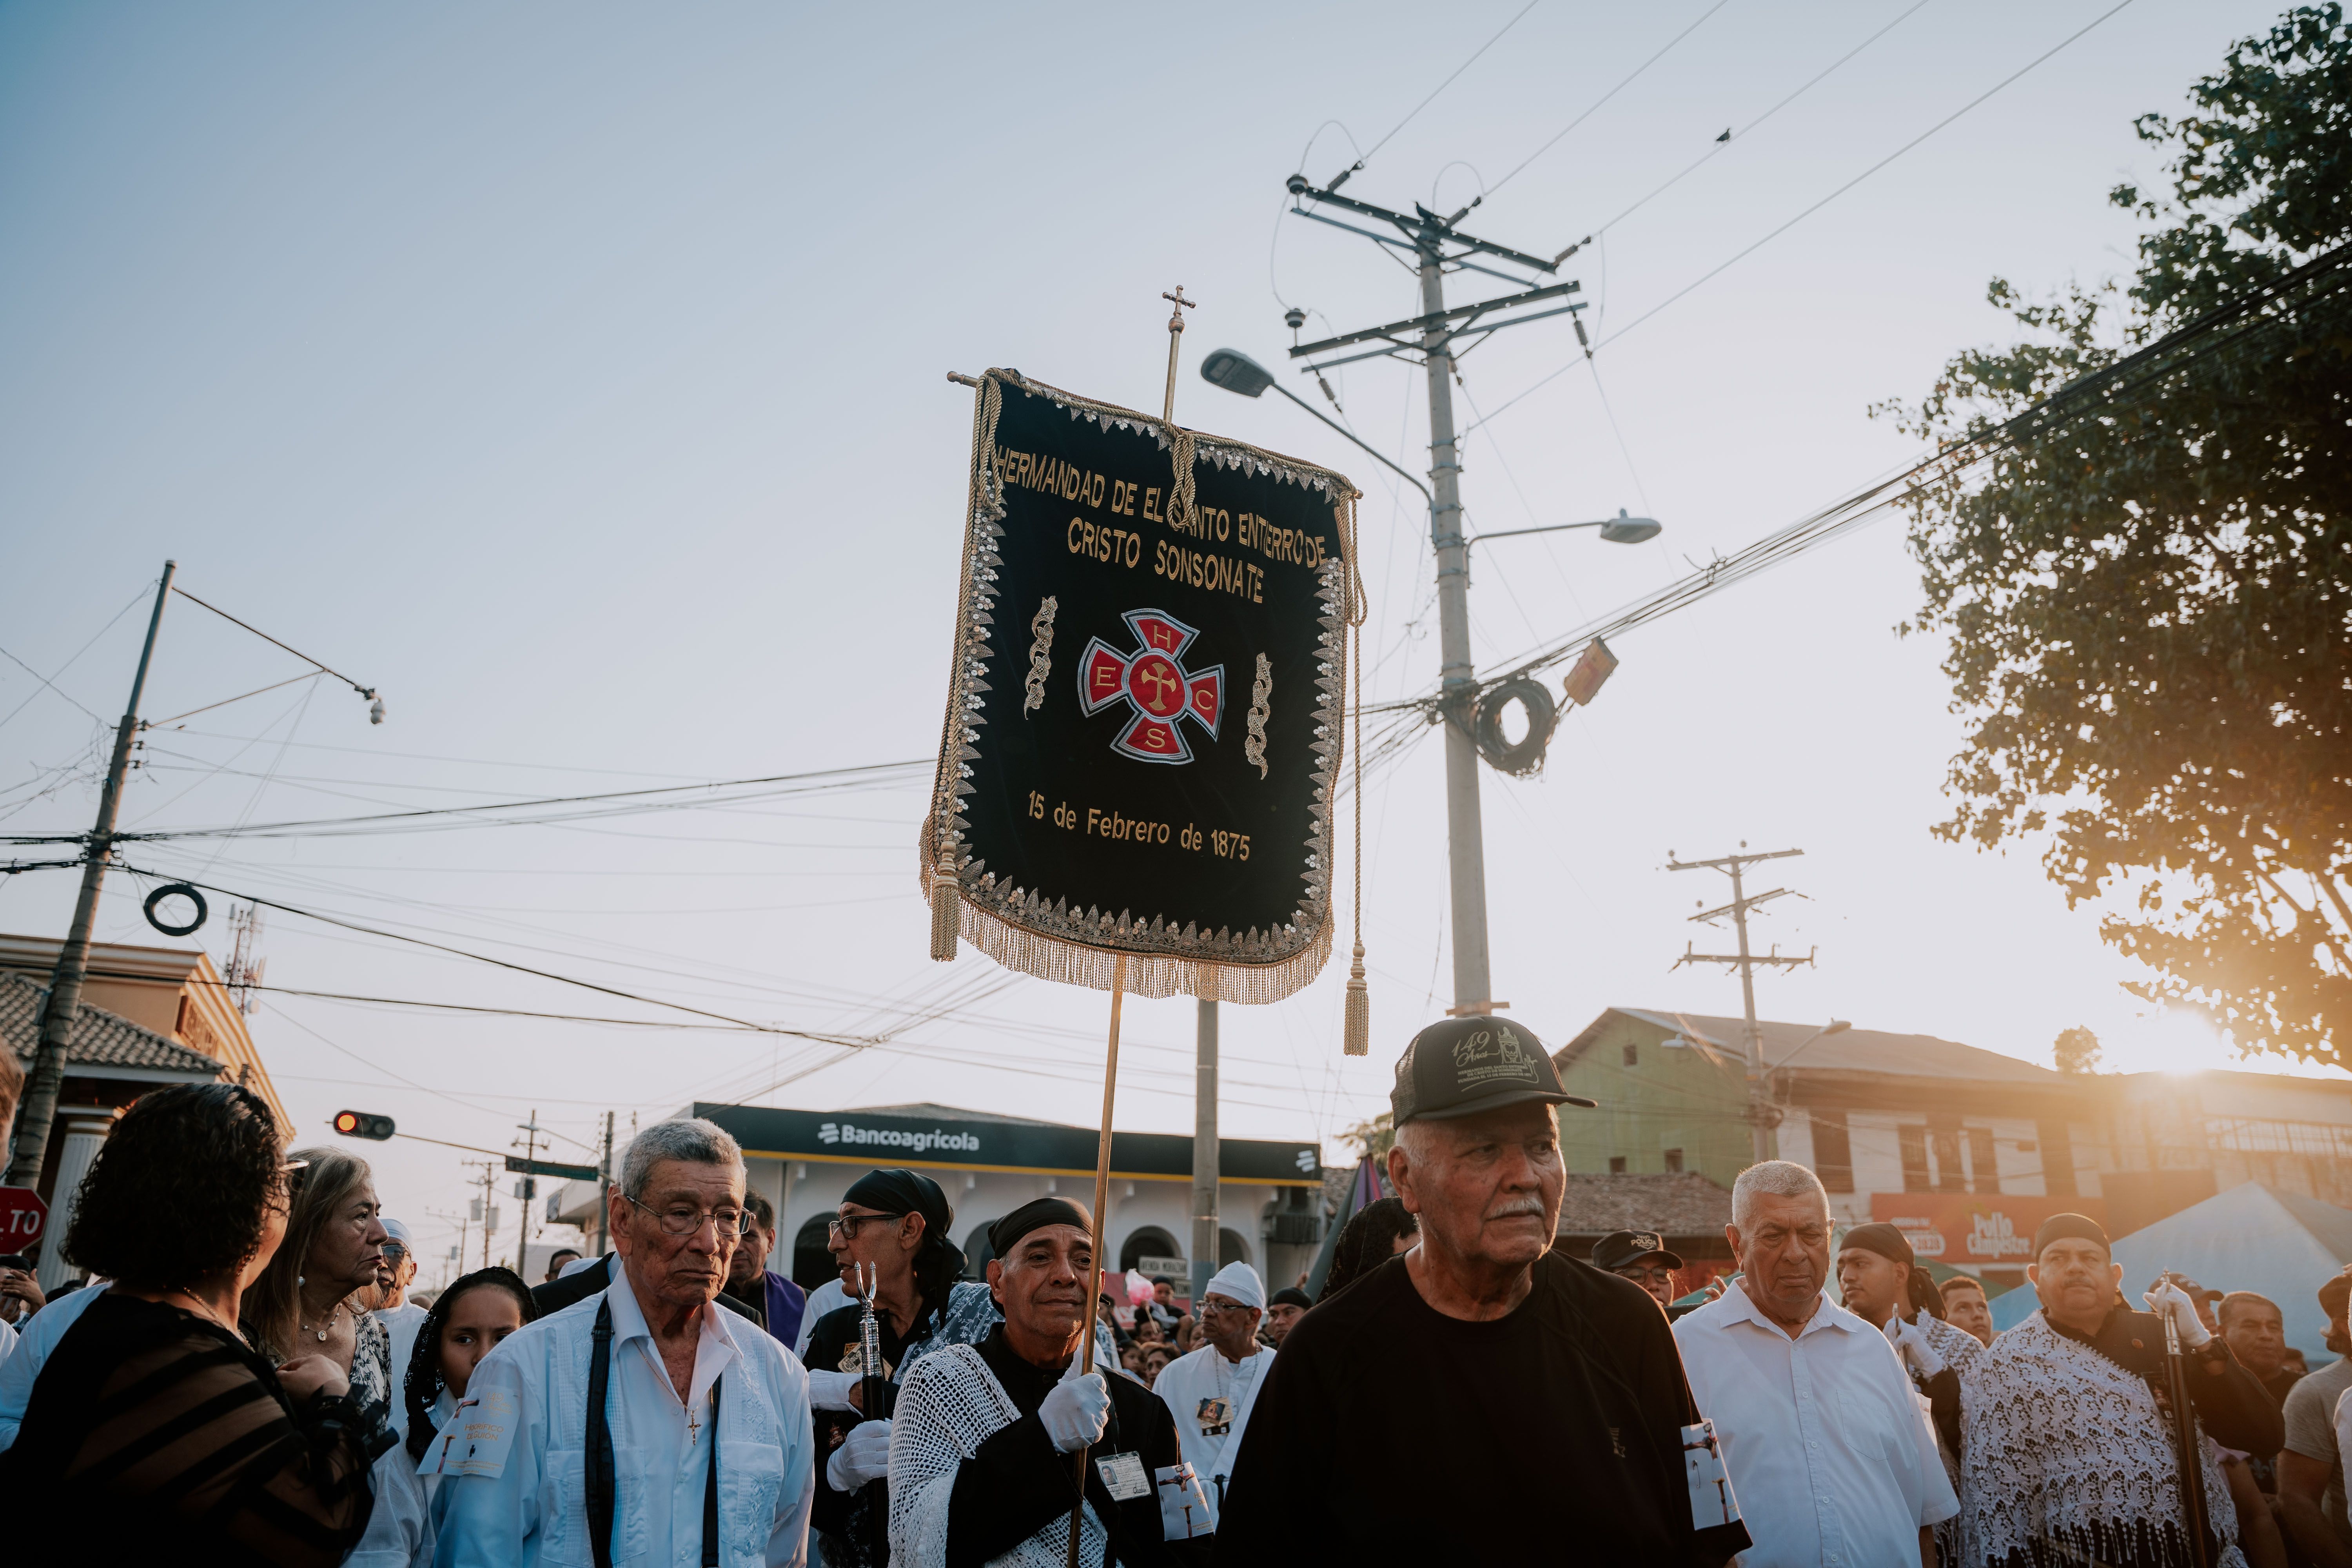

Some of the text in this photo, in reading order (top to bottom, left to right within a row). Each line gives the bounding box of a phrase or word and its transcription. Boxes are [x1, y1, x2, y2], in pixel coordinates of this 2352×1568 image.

[997, 445, 1105, 508] HERMANDAD
[1112, 479, 1138, 515] DE
[1143, 487, 1163, 523] EL
[1068, 517, 1264, 604] CRISTO SONSONATE
[1154, 625, 1171, 649] H
[1095, 666, 1116, 688] E
[1196, 690, 1213, 710] C
[1144, 728, 1165, 748] S
[1029, 790, 1250, 861] 15 de Febrero de 1875
[1451, 1031, 1490, 1057] 149
[1973, 1211, 2013, 1237] Pollo
[1967, 1233, 2030, 1259] Campestre
[486, 1392, 504, 1403] 149
[474, 1430, 498, 1441] GUIÓN
